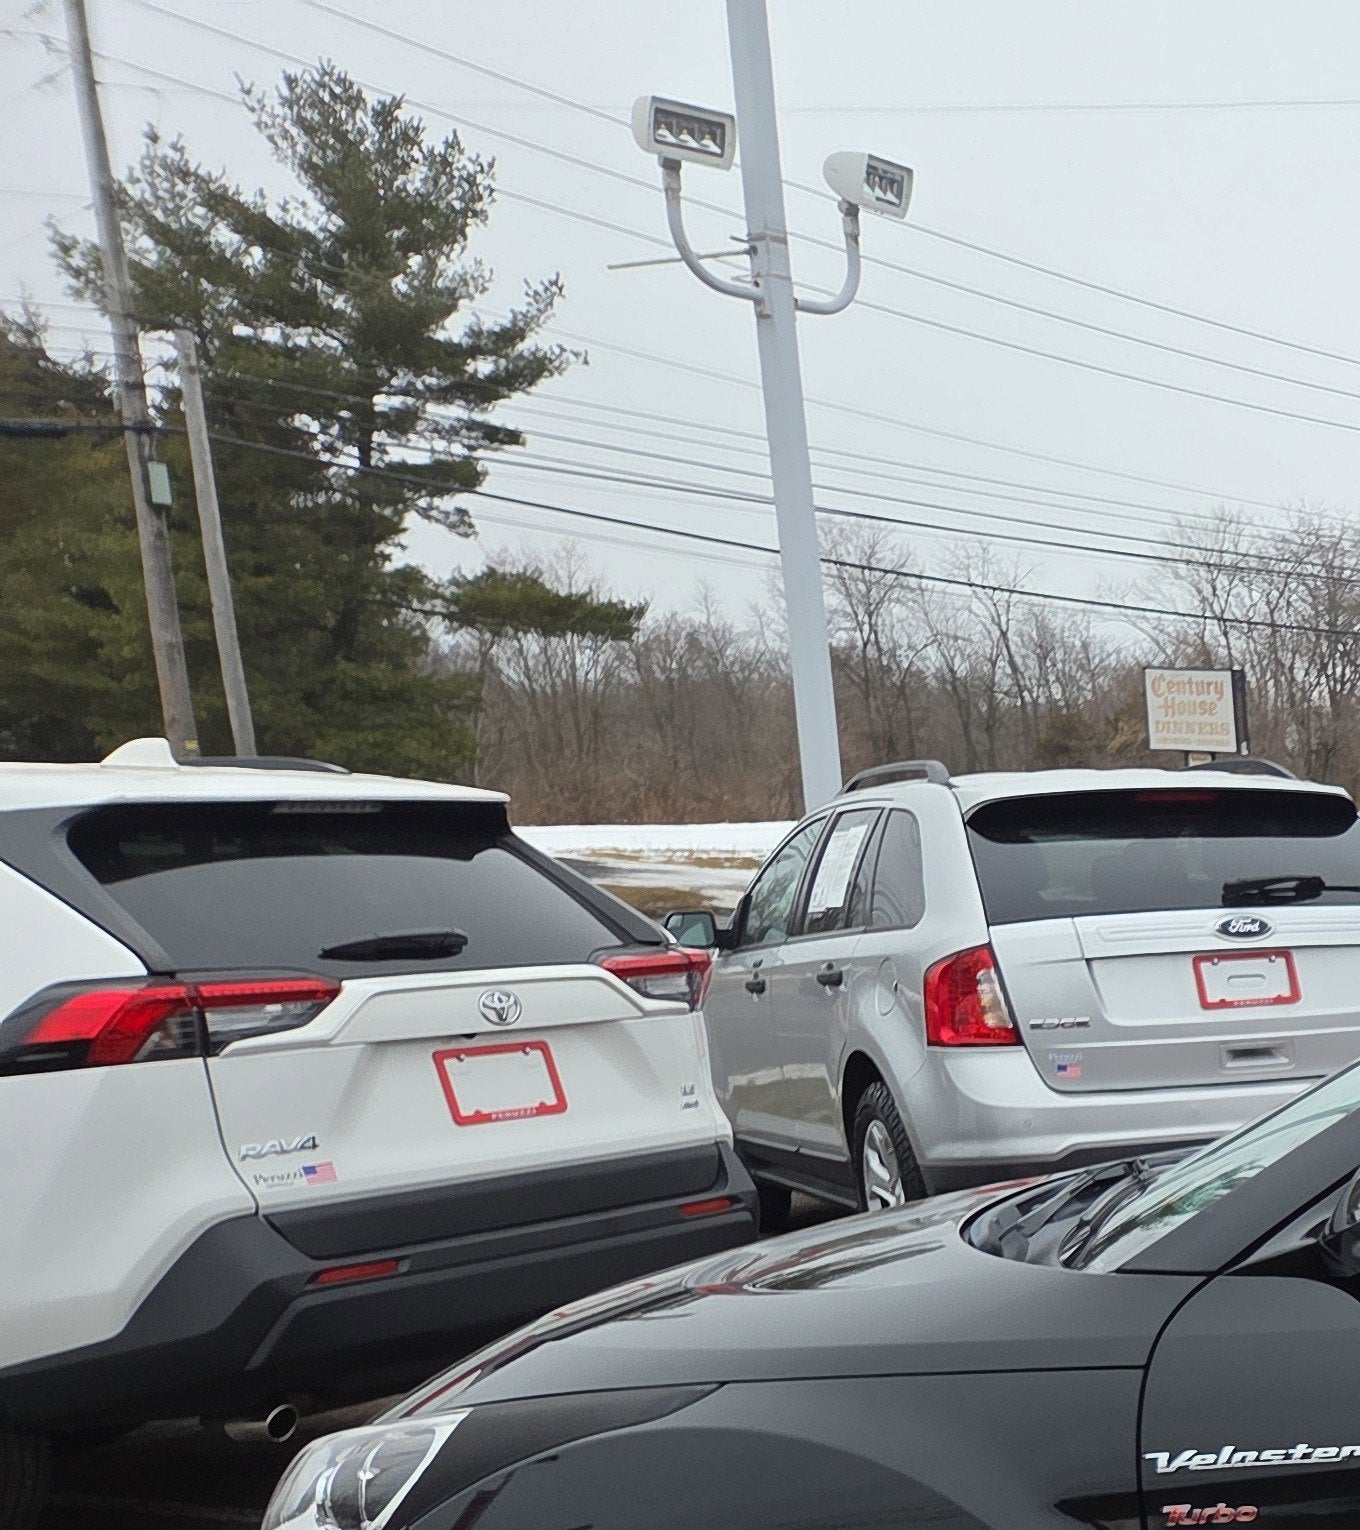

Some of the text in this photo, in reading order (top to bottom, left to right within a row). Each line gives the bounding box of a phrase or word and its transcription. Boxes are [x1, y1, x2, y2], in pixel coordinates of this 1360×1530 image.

[1150, 672, 1225, 703] Century
[1157, 695, 1218, 718] House
[238, 1132, 320, 1162] RAV4
[1161, 1502, 1260, 1527] Turbo
